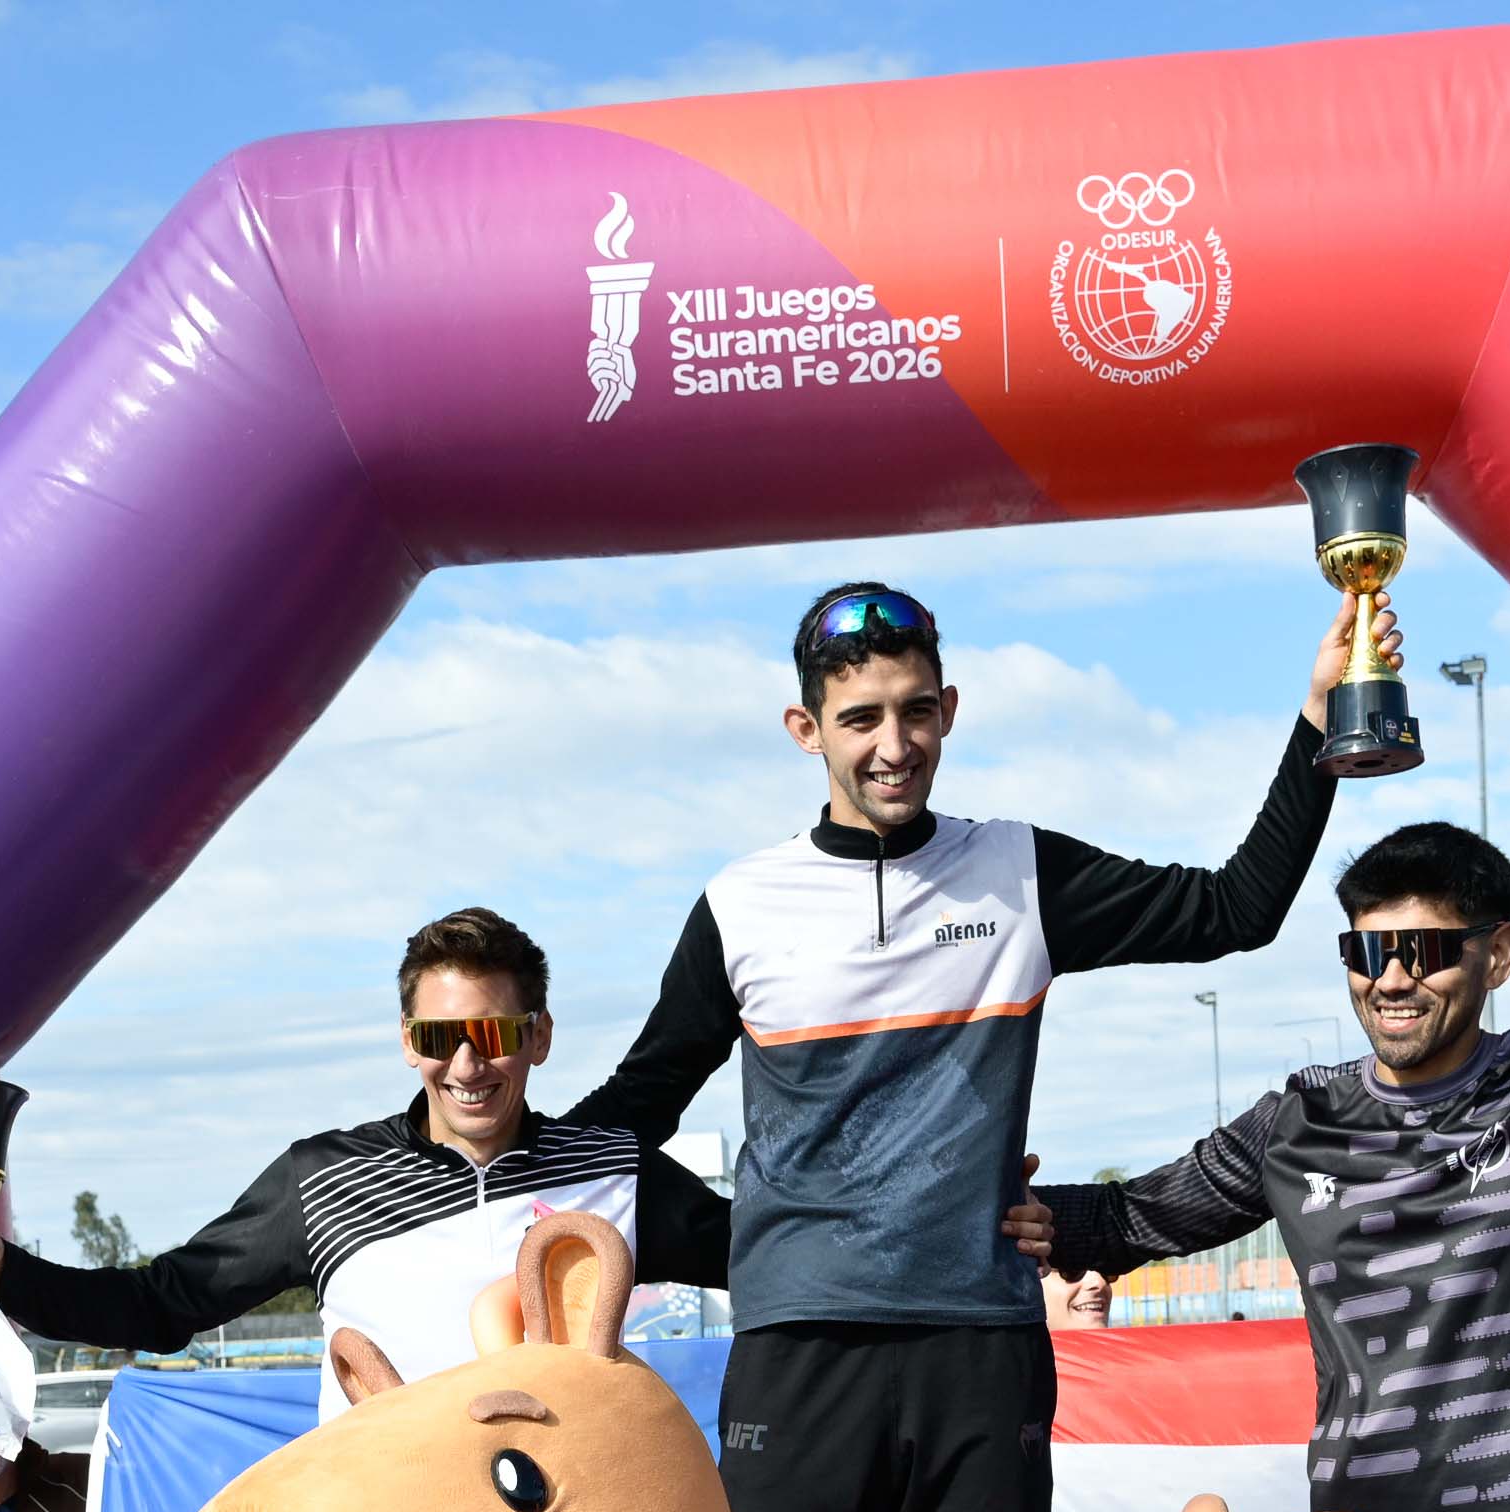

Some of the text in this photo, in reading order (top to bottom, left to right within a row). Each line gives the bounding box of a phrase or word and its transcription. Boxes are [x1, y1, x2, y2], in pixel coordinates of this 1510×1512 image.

[1101, 229, 1177, 251] ODESUR
[666, 283, 876, 325] XIII Juegos
[1049, 226, 1233, 386] ORGANIZACION DEPORTIVA SURAMERICANA
[669, 312, 962, 361] Suramericanos
[672, 346, 943, 396] Santa Fe 2026
[726, 1421, 768, 1451] UFC
